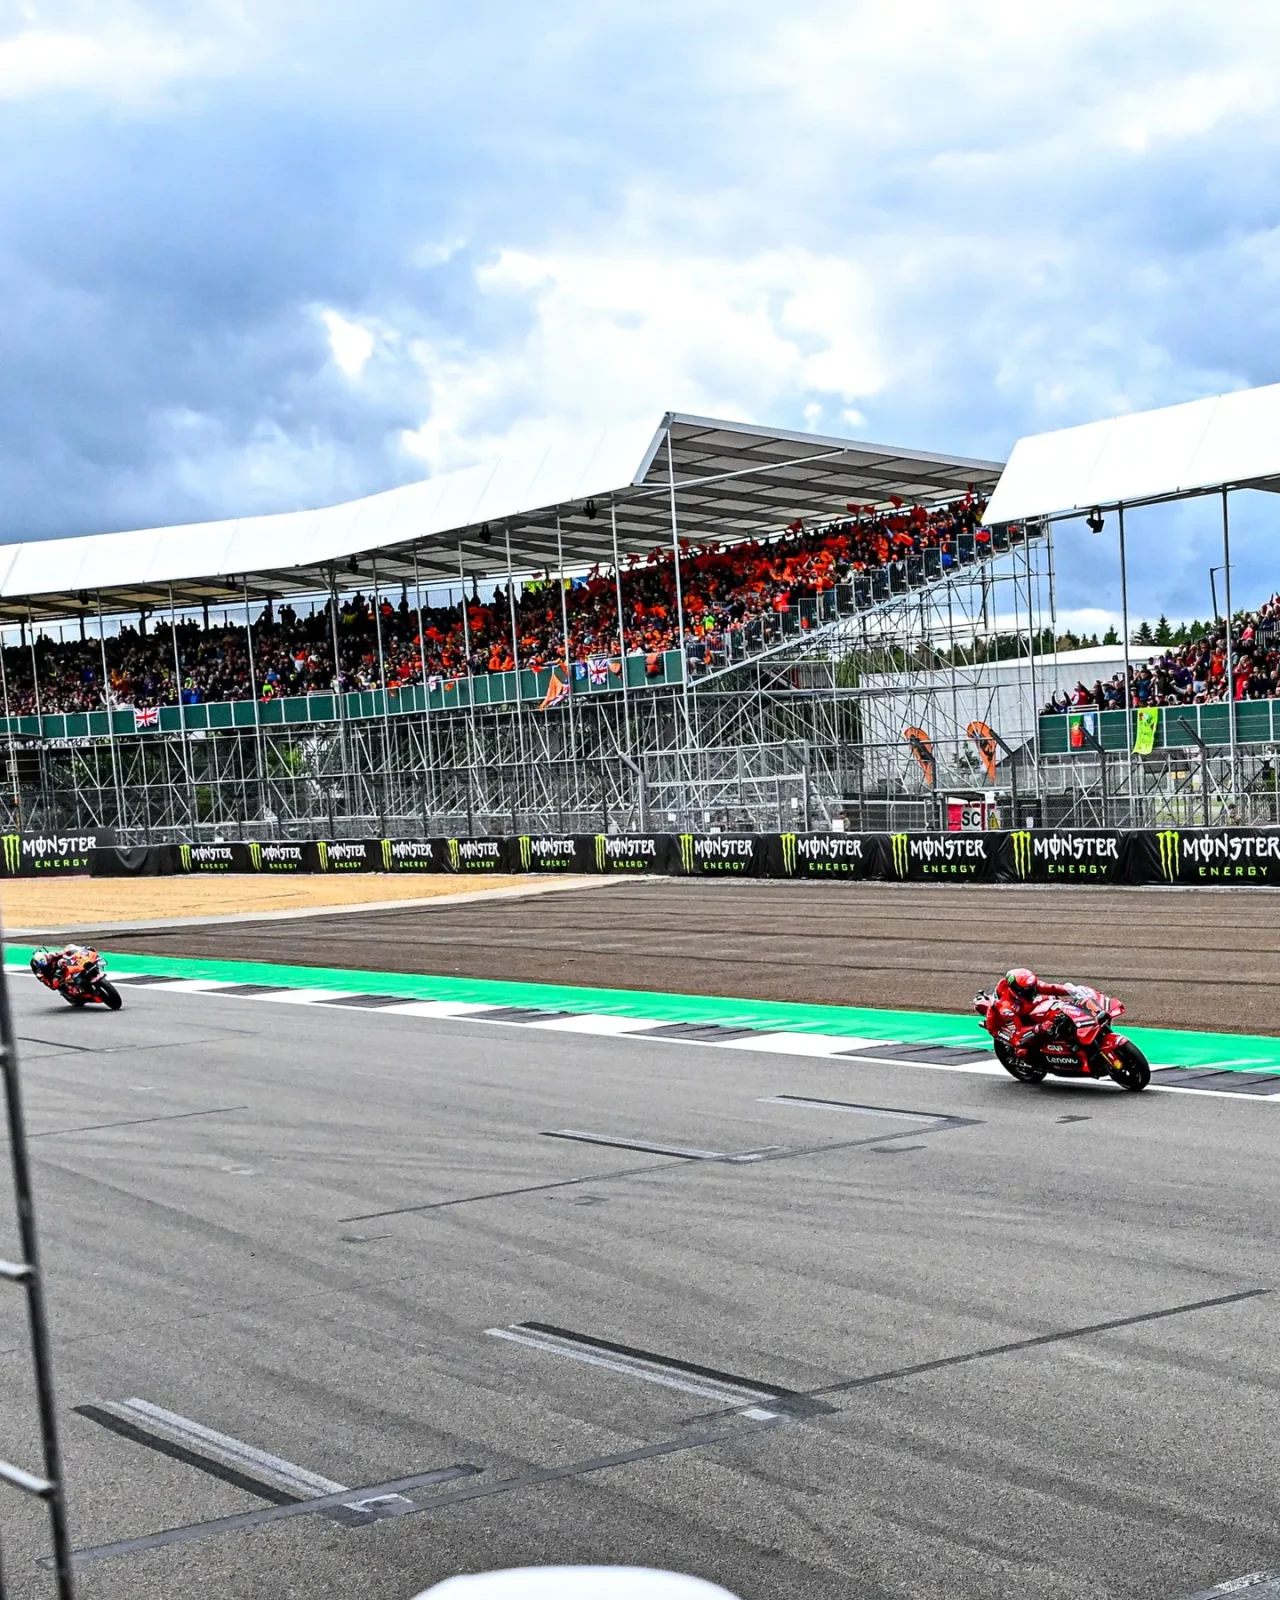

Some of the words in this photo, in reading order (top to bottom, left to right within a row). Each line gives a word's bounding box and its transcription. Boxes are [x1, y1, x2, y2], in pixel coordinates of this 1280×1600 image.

[961, 810, 982, 827] SC
[21, 836, 96, 857] MONSTER
[191, 844, 233, 861] MONSTER
[261, 844, 302, 861] MONSTER
[327, 844, 366, 860] MONSTER
[391, 841, 433, 860] MONSTER
[459, 841, 499, 860] MONSTER
[531, 837, 576, 857] MONSTER
[605, 837, 656, 858] MONSTER
[695, 837, 754, 859] MONSTER
[797, 837, 863, 860] MONSTER
[909, 836, 988, 860] MONSTER
[1034, 834, 1119, 860] MONSTER
[35, 859, 88, 867] ENERGY
[613, 860, 648, 868] ENERGY
[704, 861, 746, 870] ENERGY
[809, 862, 855, 871] ENERGY
[923, 864, 976, 874] ENERGY
[1048, 864, 1108, 875] ENERGY
[1199, 866, 1268, 877] ENERGY
